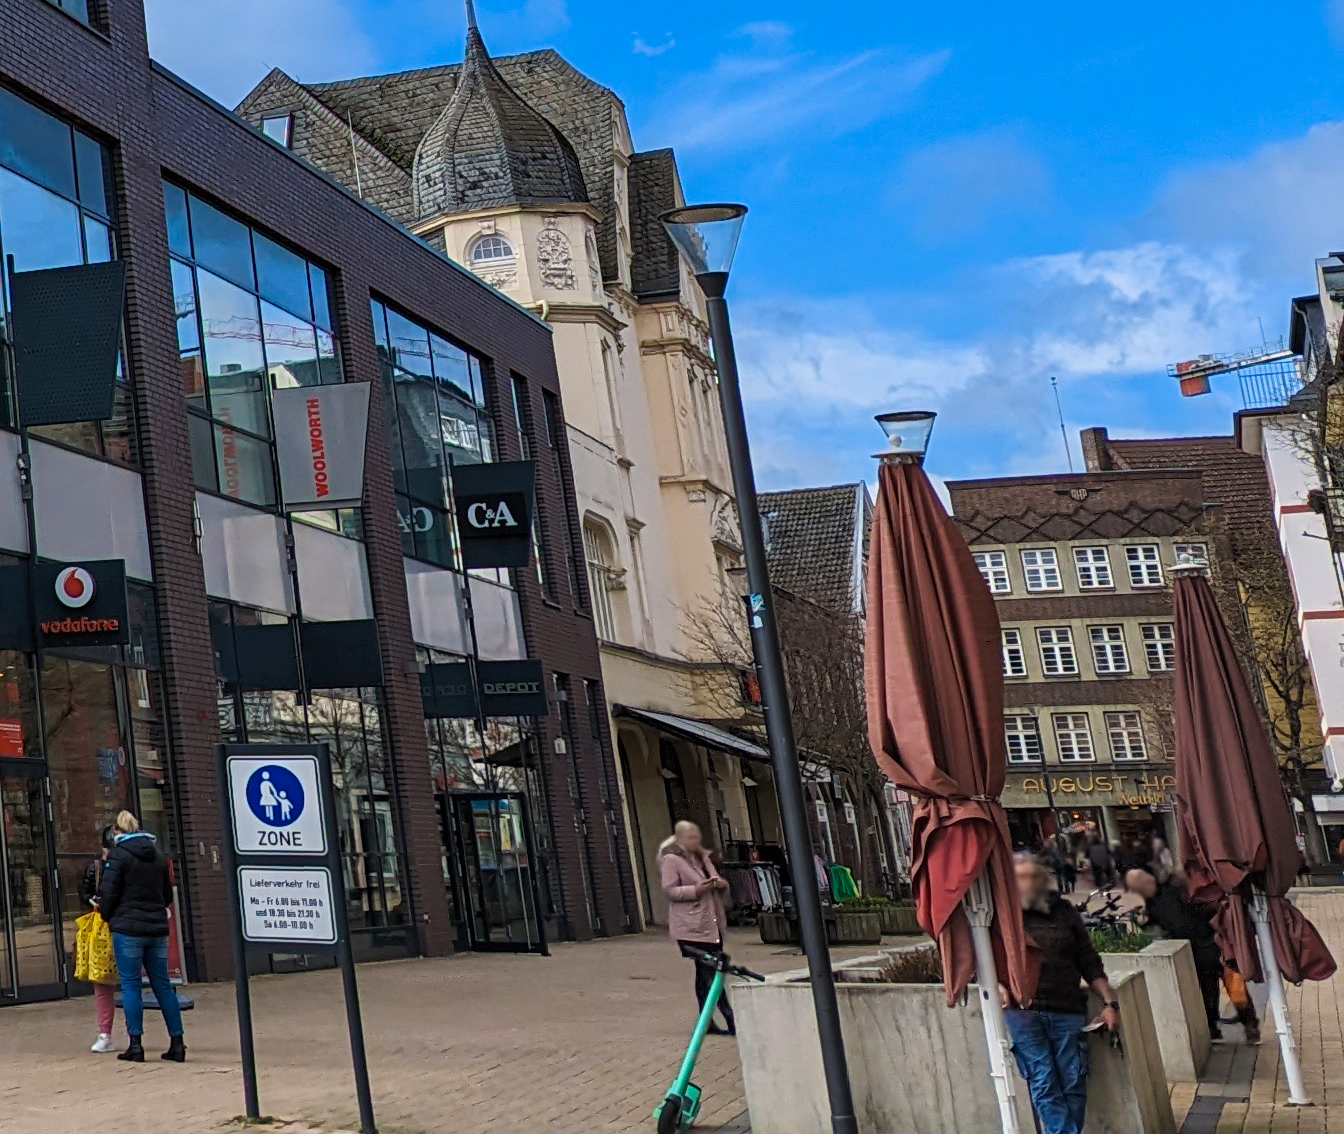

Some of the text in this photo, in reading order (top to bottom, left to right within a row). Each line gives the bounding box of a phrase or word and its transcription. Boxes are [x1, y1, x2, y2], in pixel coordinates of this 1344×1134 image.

[306, 397, 329, 497] WOOLWORTH
[467, 501, 518, 528] C&A
[41, 616, 119, 633] vodafone
[483, 682, 540, 694] DEPOT
[1022, 775, 1128, 793] AUGUST
[257, 831, 303, 846] ZONE
[250, 878, 320, 888] Lieferverkehr frei
